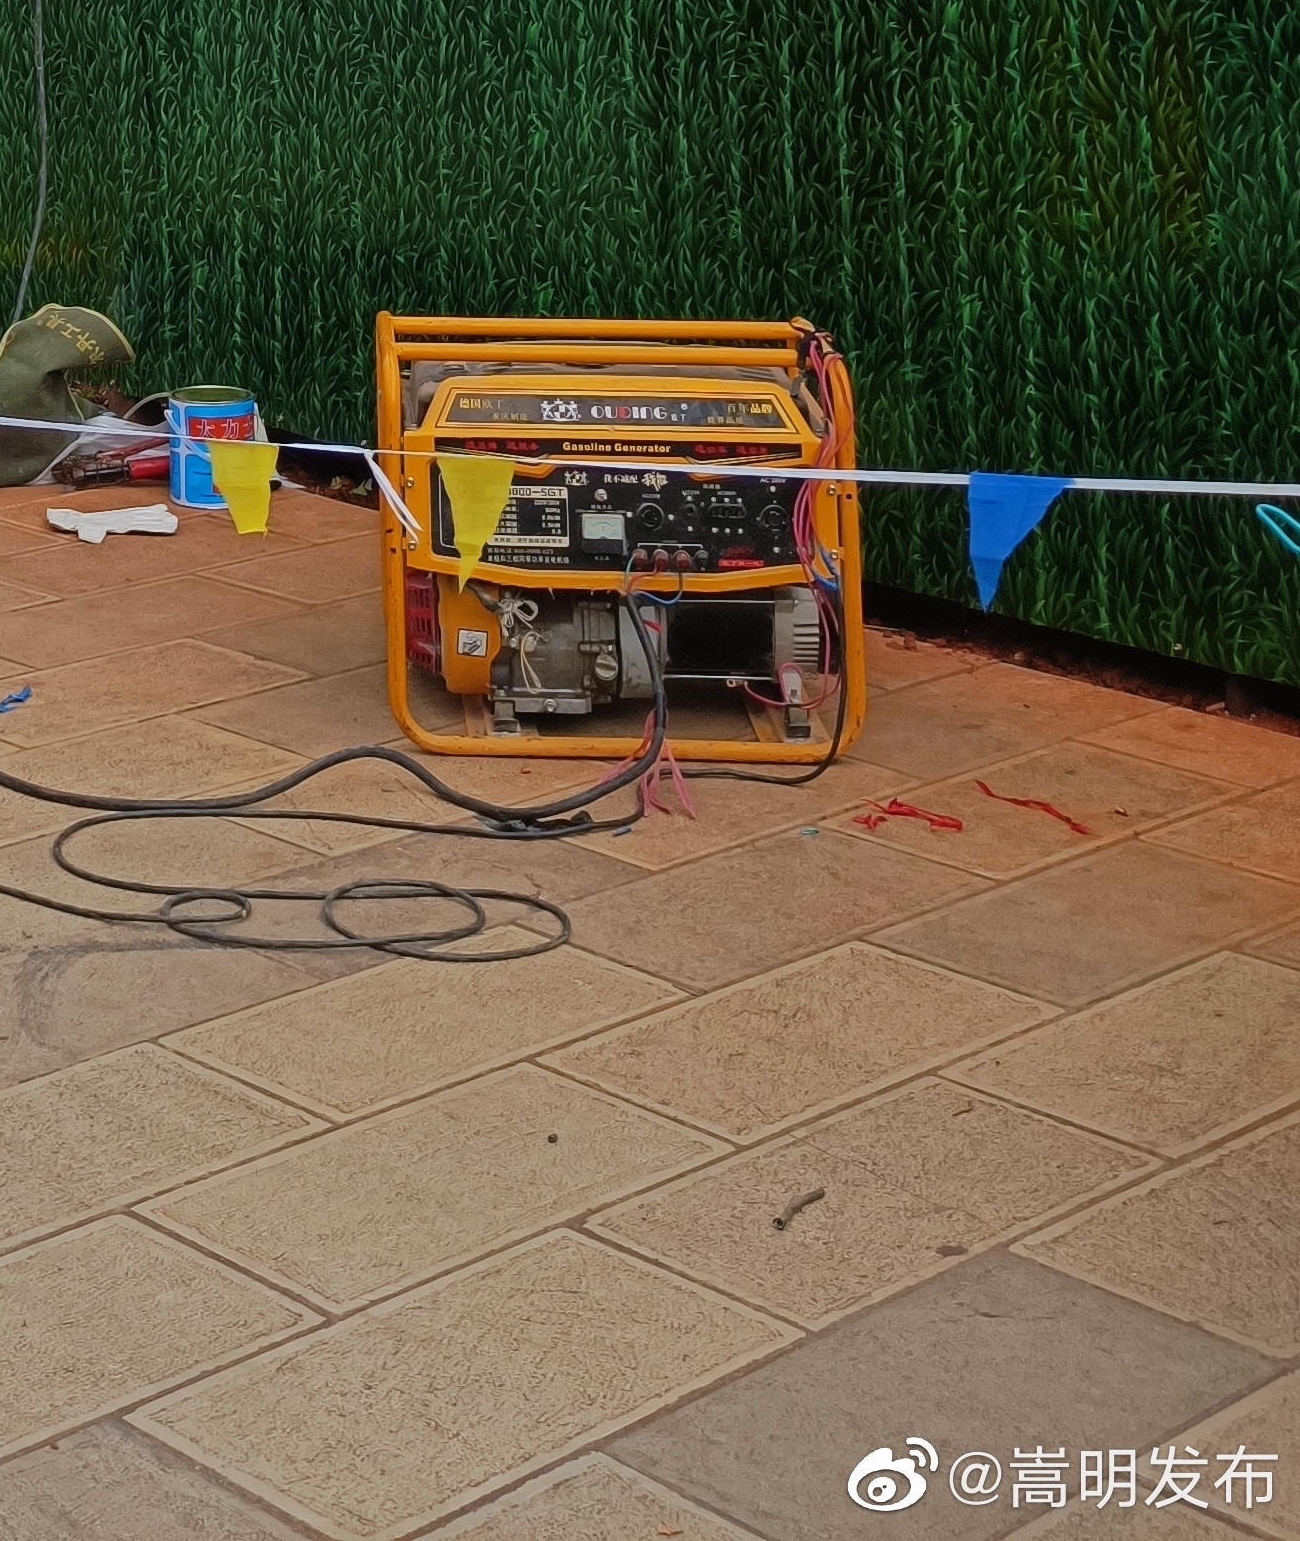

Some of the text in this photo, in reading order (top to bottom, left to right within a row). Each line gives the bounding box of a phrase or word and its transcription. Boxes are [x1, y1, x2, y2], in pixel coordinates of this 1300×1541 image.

[590, 405, 668, 420] OUDING
[562, 441, 671, 453] Gasoline Generator
